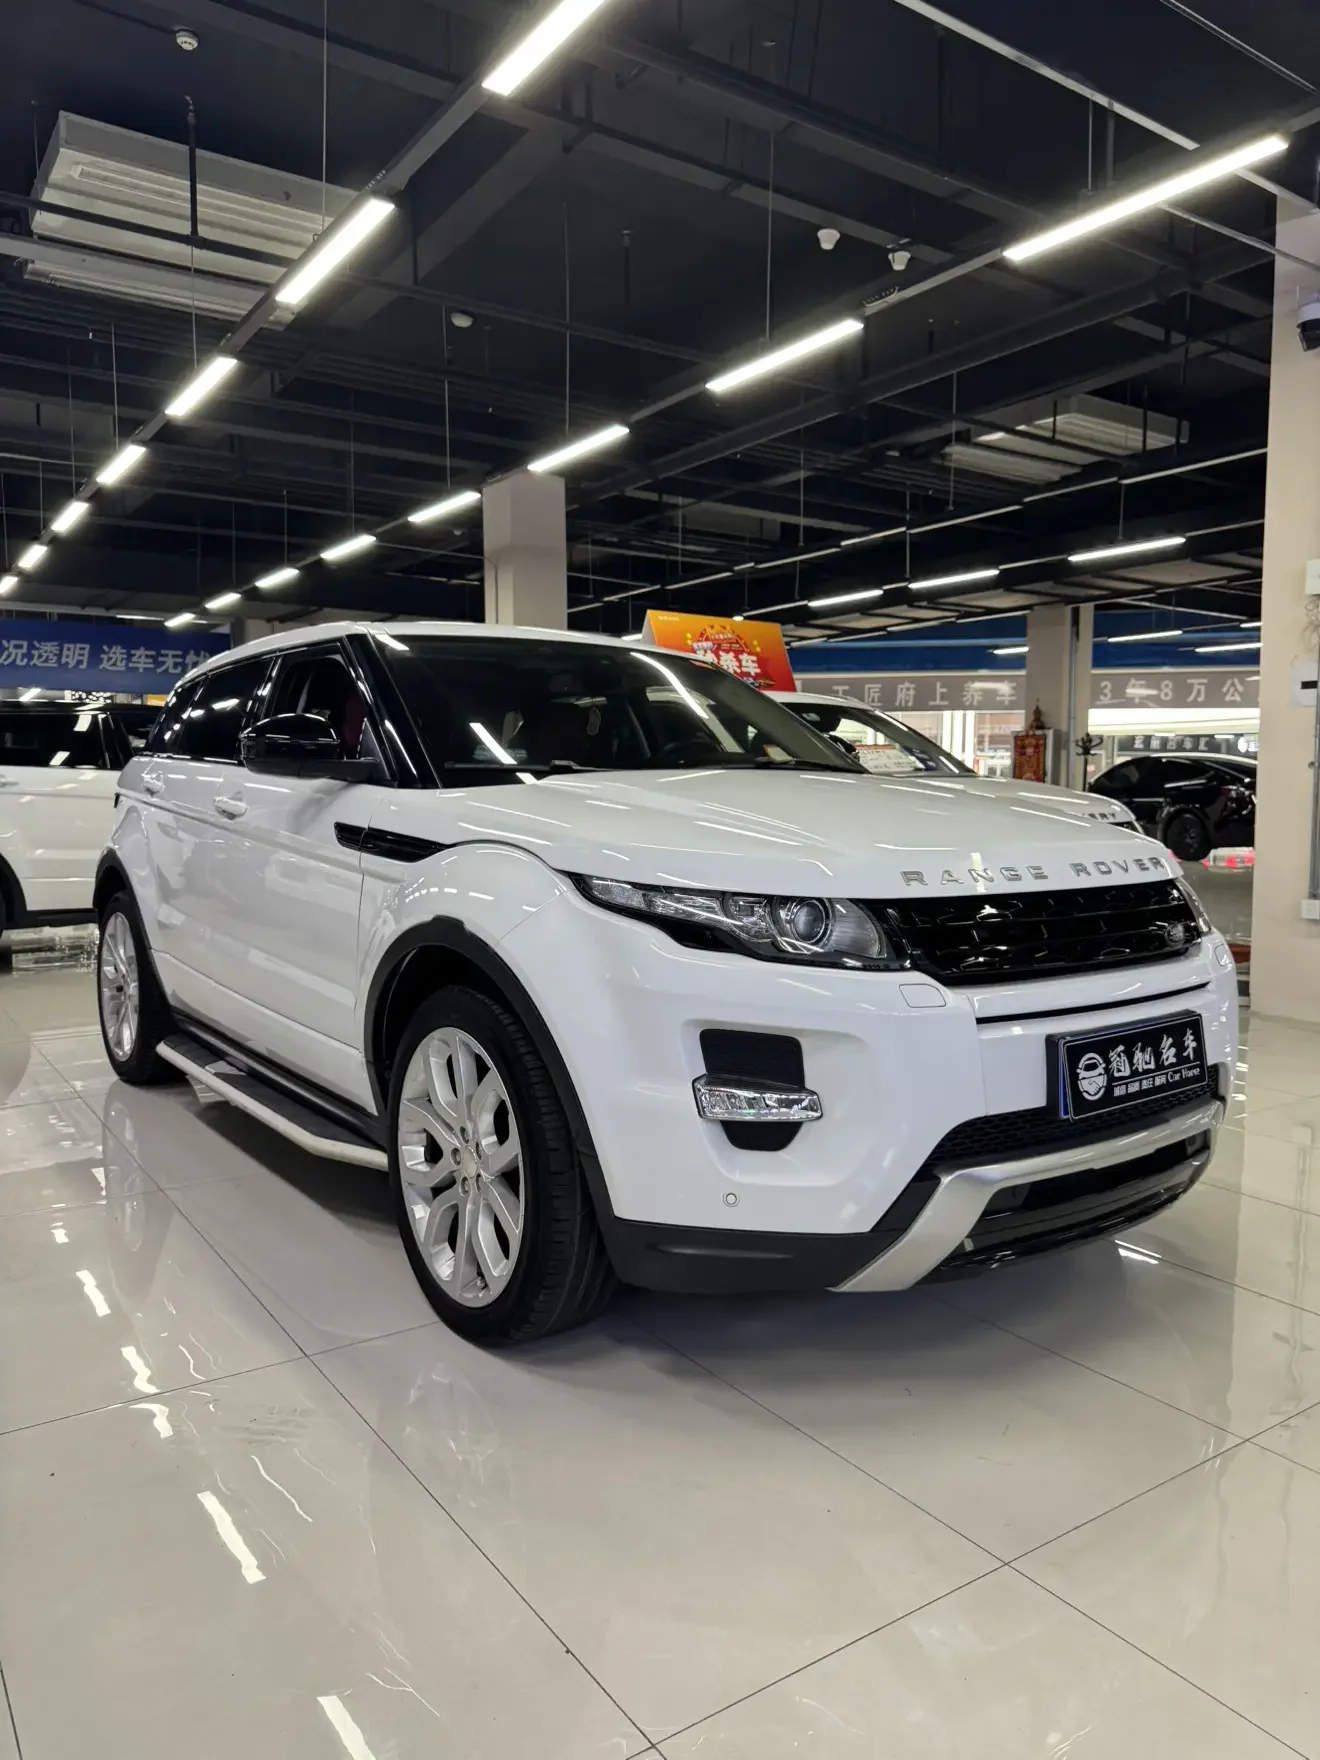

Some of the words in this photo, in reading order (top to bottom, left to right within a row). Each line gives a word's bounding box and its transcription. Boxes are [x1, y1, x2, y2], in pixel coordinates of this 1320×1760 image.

[900, 866, 1048, 886] RANGE
[1069, 856, 1166, 877] ROVER
[1168, 1069, 1180, 1082] Car
